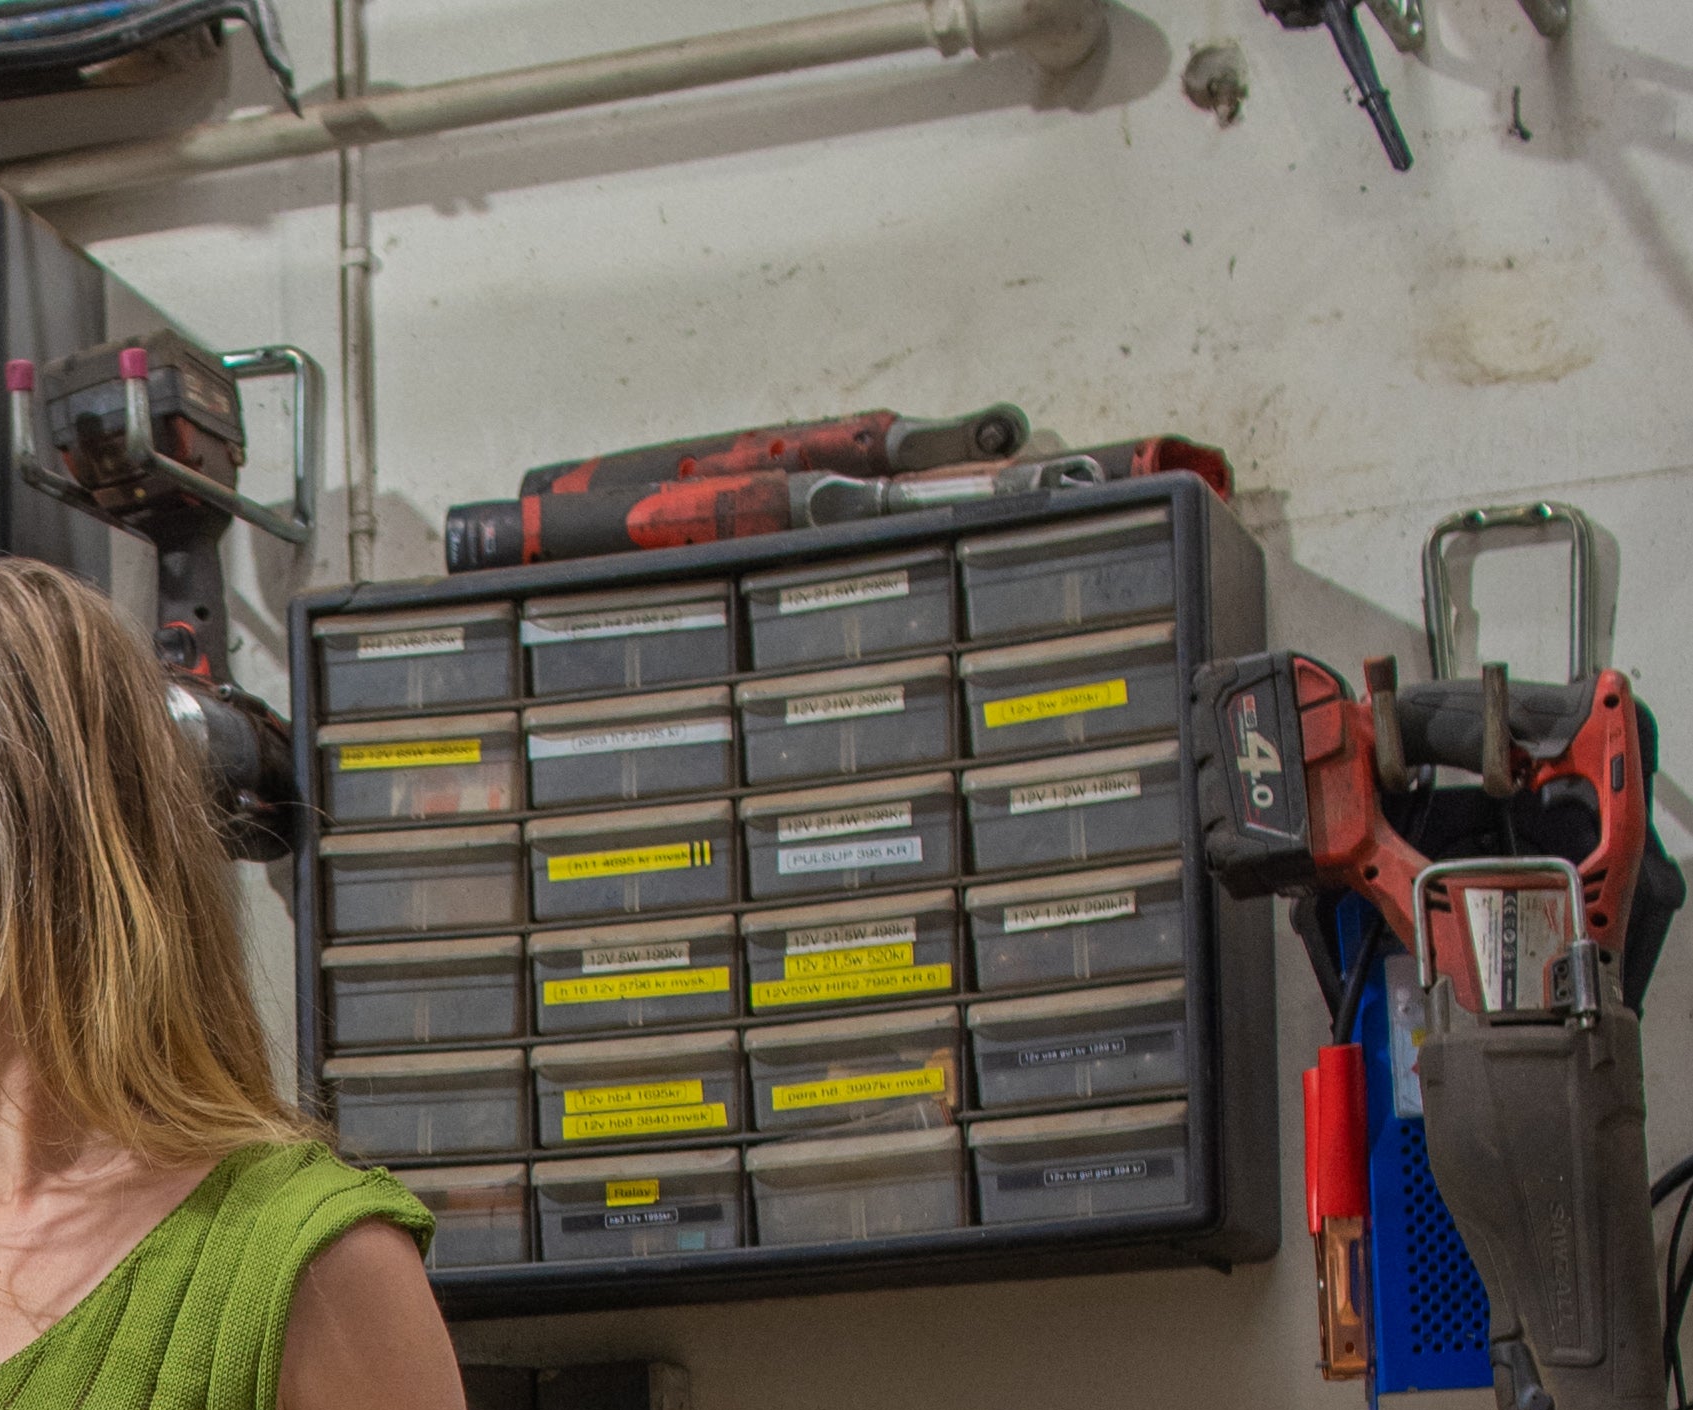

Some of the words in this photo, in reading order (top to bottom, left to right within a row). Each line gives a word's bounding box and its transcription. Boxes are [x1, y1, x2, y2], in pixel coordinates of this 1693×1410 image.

[638, 854, 652, 864] kr
[794, 934, 820, 946] 12V
[590, 953, 614, 966] 12V
[618, 951, 641, 964] 5W
[795, 959, 817, 972] 12v
[594, 983, 614, 993] 12v
[654, 978, 668, 988] kr
[581, 1095, 602, 1105] 12v
[607, 1092, 631, 1103] hb4
[583, 1120, 605, 1131] 12v
[672, 1112, 708, 1123] mvsk
